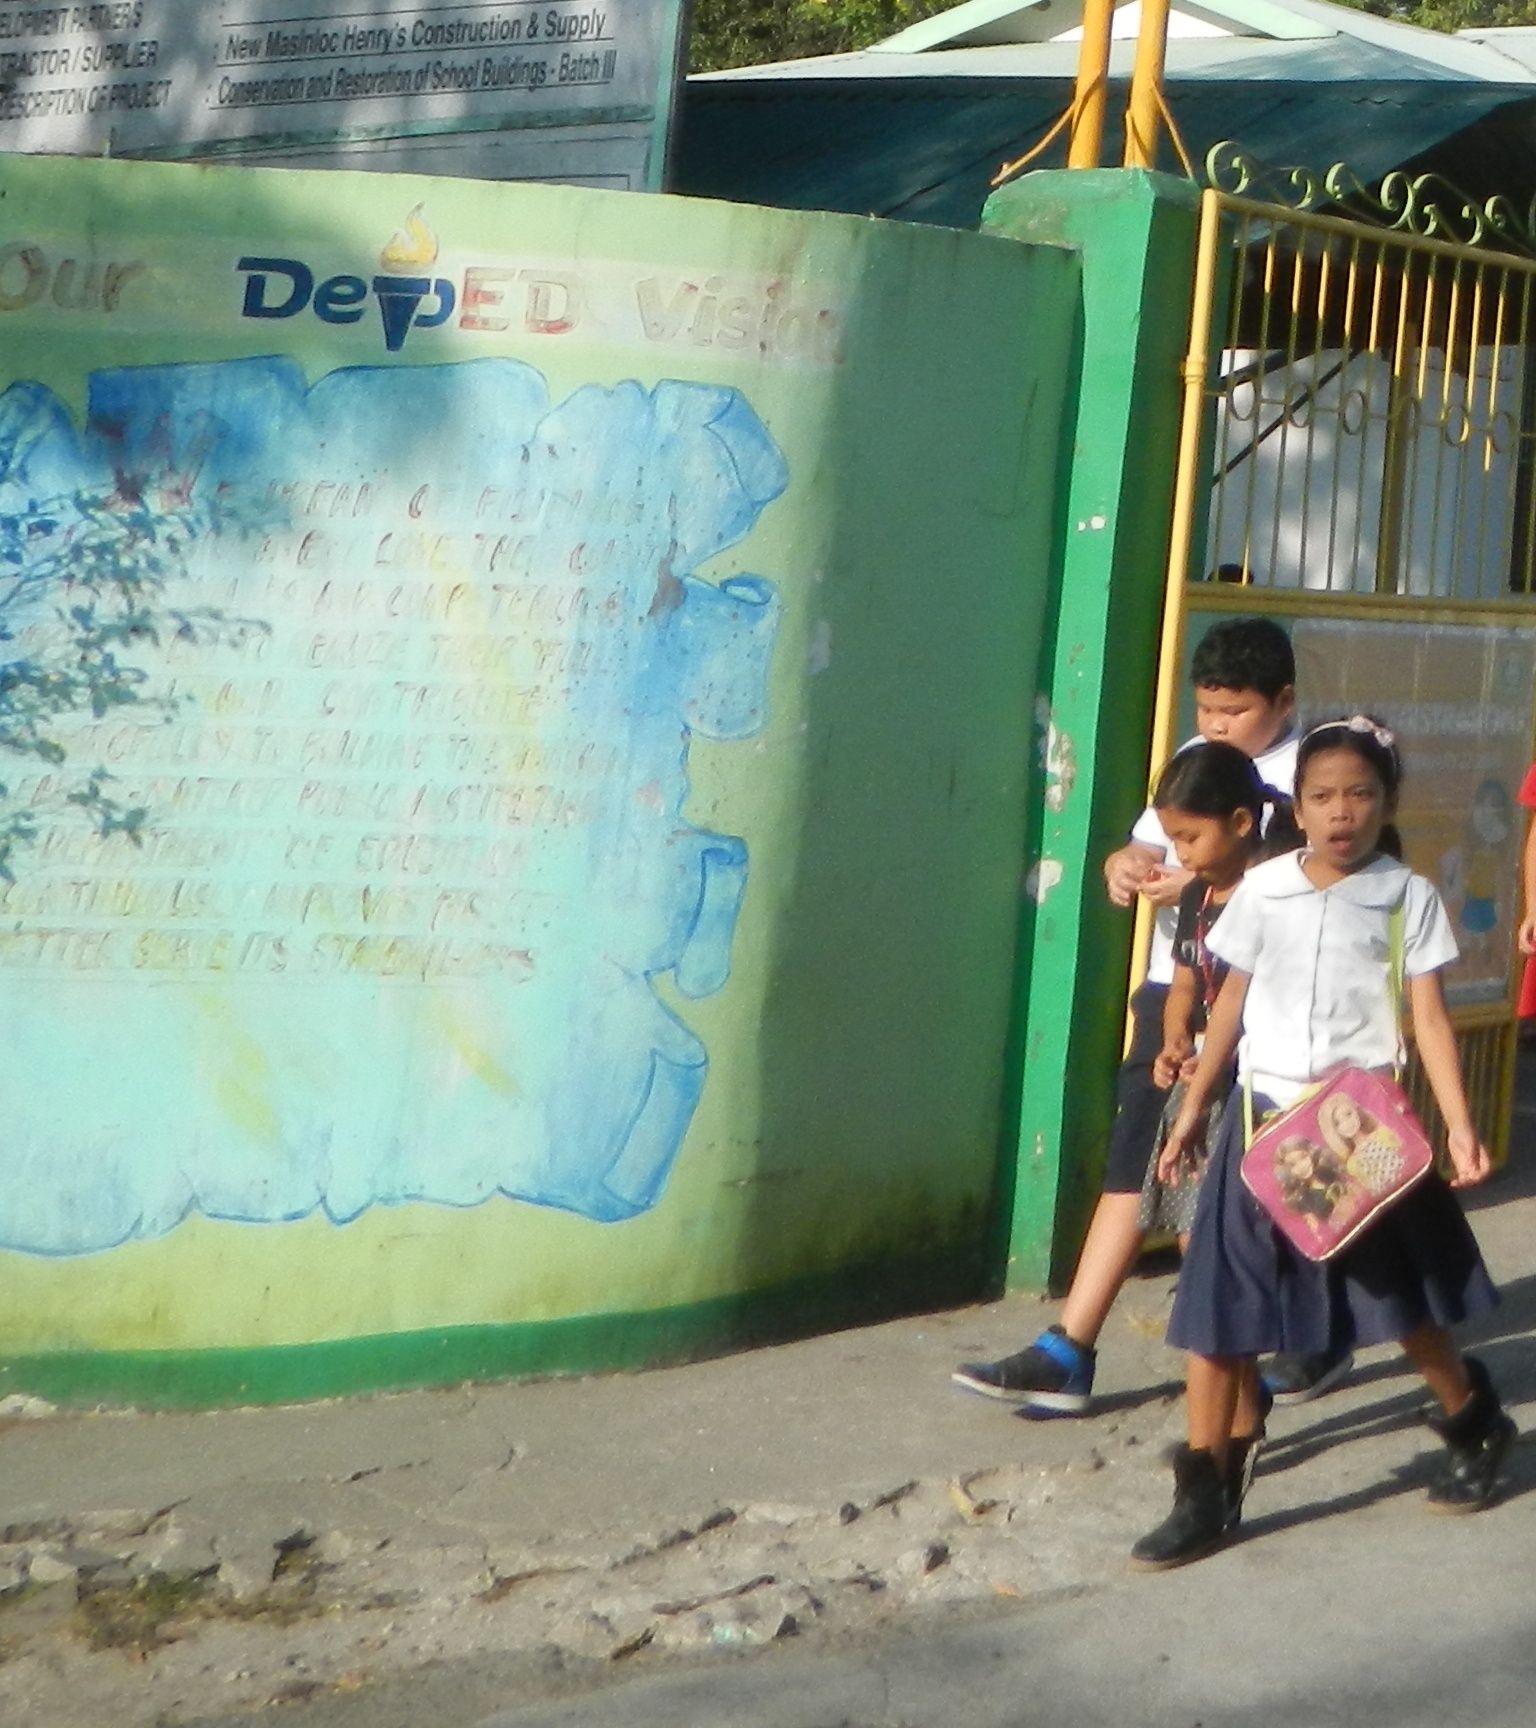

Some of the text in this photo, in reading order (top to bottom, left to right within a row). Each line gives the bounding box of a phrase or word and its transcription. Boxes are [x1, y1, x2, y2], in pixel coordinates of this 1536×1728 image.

[226, 33, 261, 61] New
[411, 13, 522, 47] Construction
[526, 11, 540, 39] &
[544, 7, 607, 43] Supply
[431, 57, 480, 91] School
[557, 51, 601, 84] Batch
[635, 273, 845, 366] Vision
